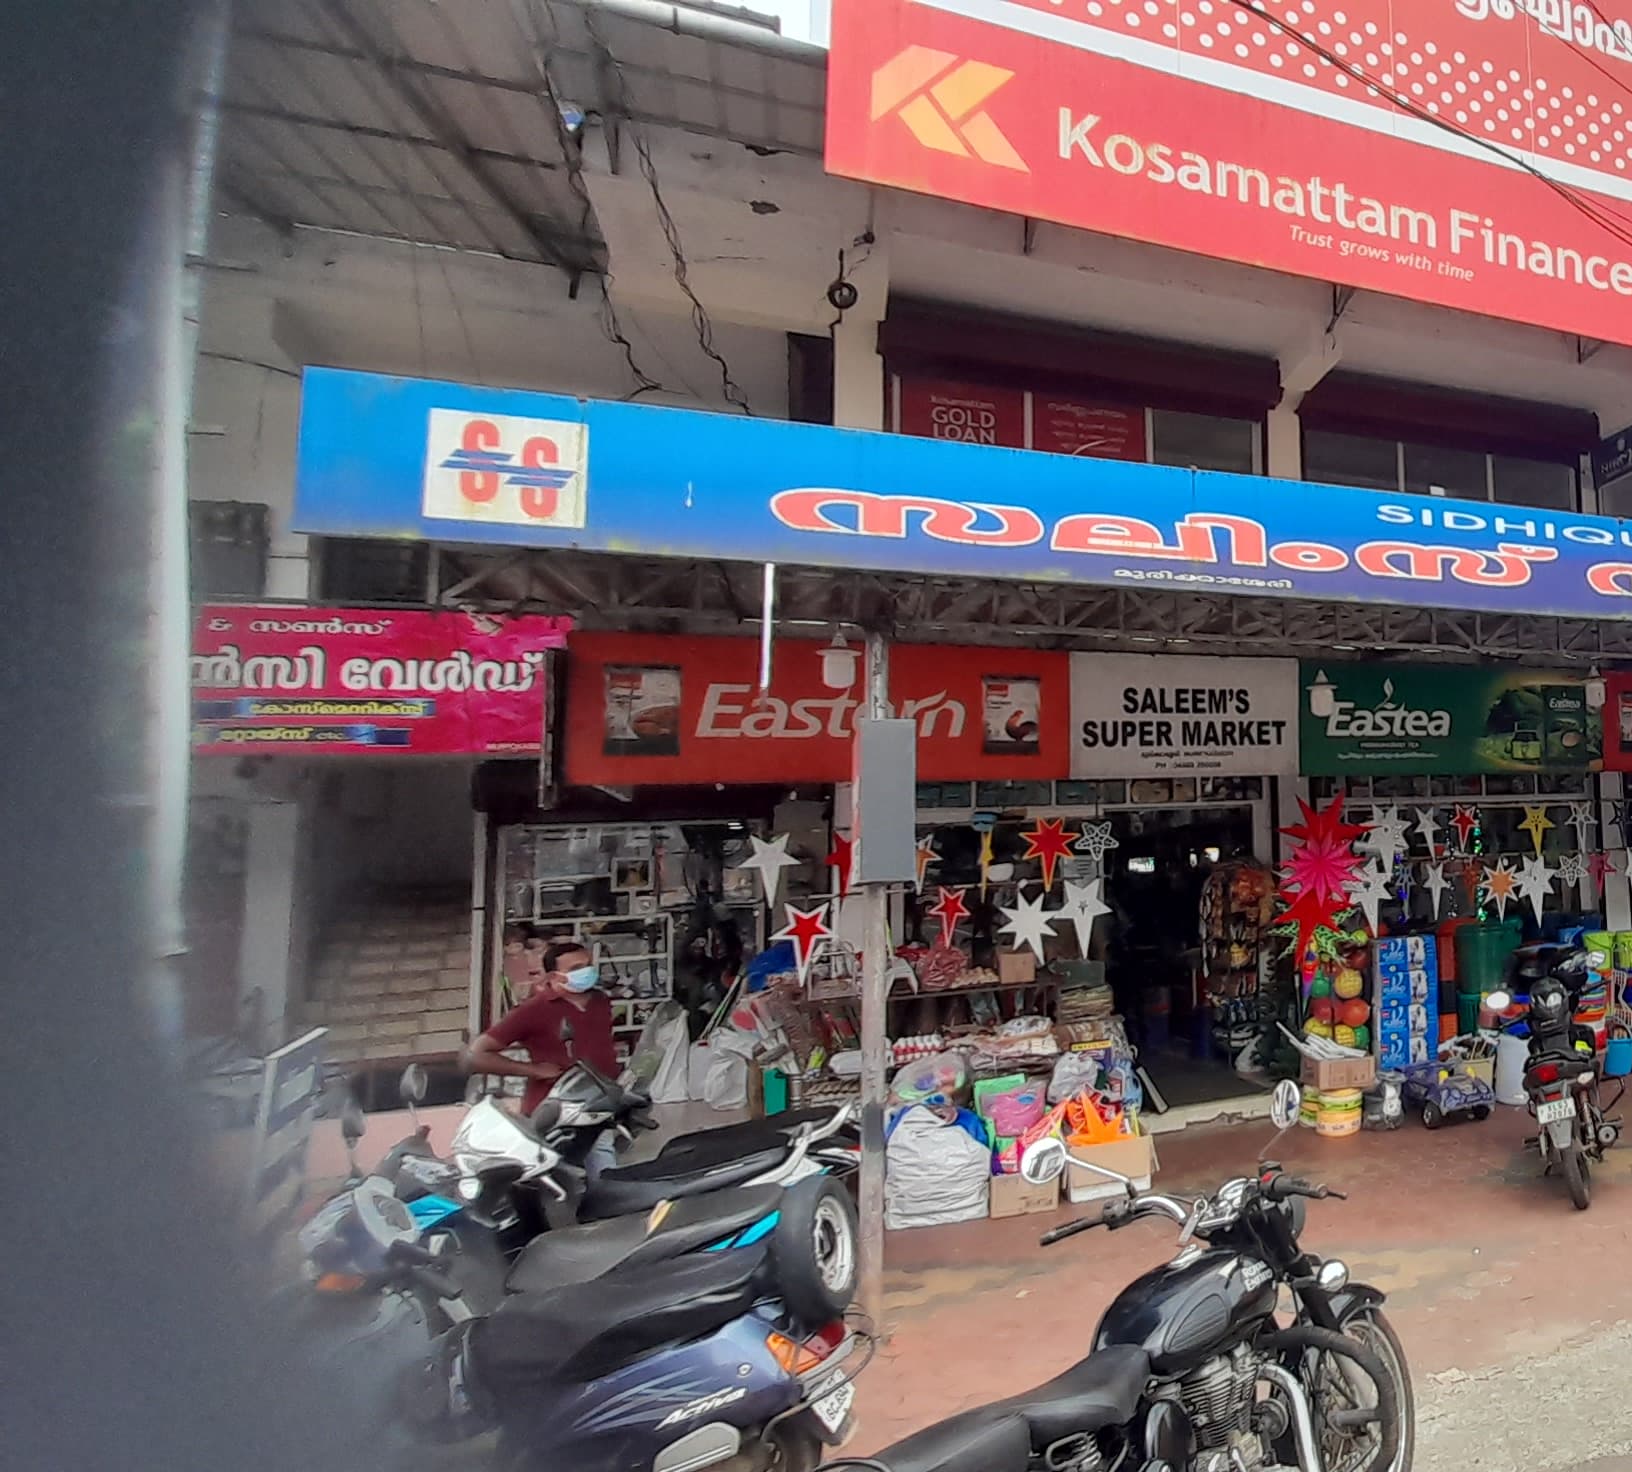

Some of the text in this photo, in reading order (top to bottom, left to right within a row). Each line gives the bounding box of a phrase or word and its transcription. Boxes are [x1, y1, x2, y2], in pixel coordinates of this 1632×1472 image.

[1059, 107, 1437, 249] Kosamattam
[1289, 225, 1475, 281] Trust grows with time
[932, 406, 996, 429] GOLD
[933, 423, 996, 444] LOAN
[208, 619, 232, 631] &
[1122, 687, 1250, 715] SALEEM'S
[1325, 699, 1451, 738] Eastea
[1083, 719, 1286, 747] SUPER MARKET
[654, 1387, 746, 1431] Activa
